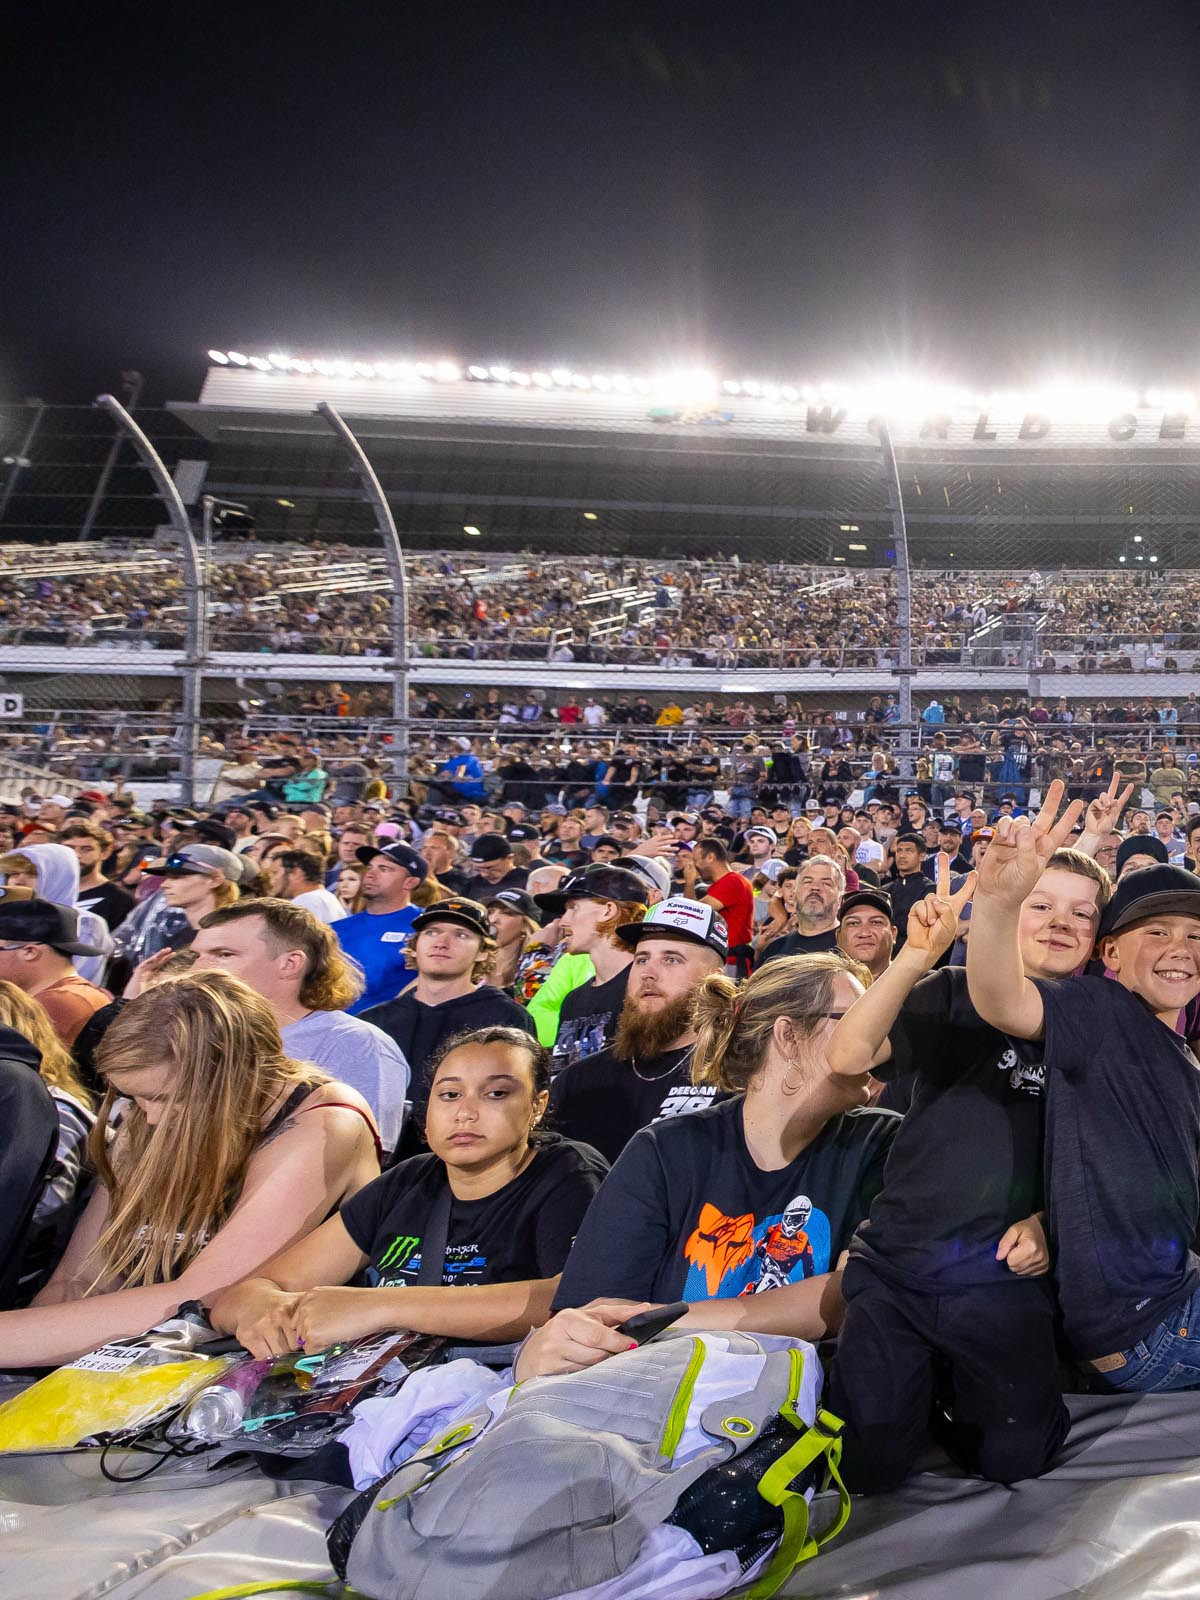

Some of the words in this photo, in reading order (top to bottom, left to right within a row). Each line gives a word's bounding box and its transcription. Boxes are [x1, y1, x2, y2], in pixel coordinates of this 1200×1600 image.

[5, 699, 18, 711] D
[667, 902, 704, 915] Kawasaki
[668, 1086, 718, 1097] DEEGAN
